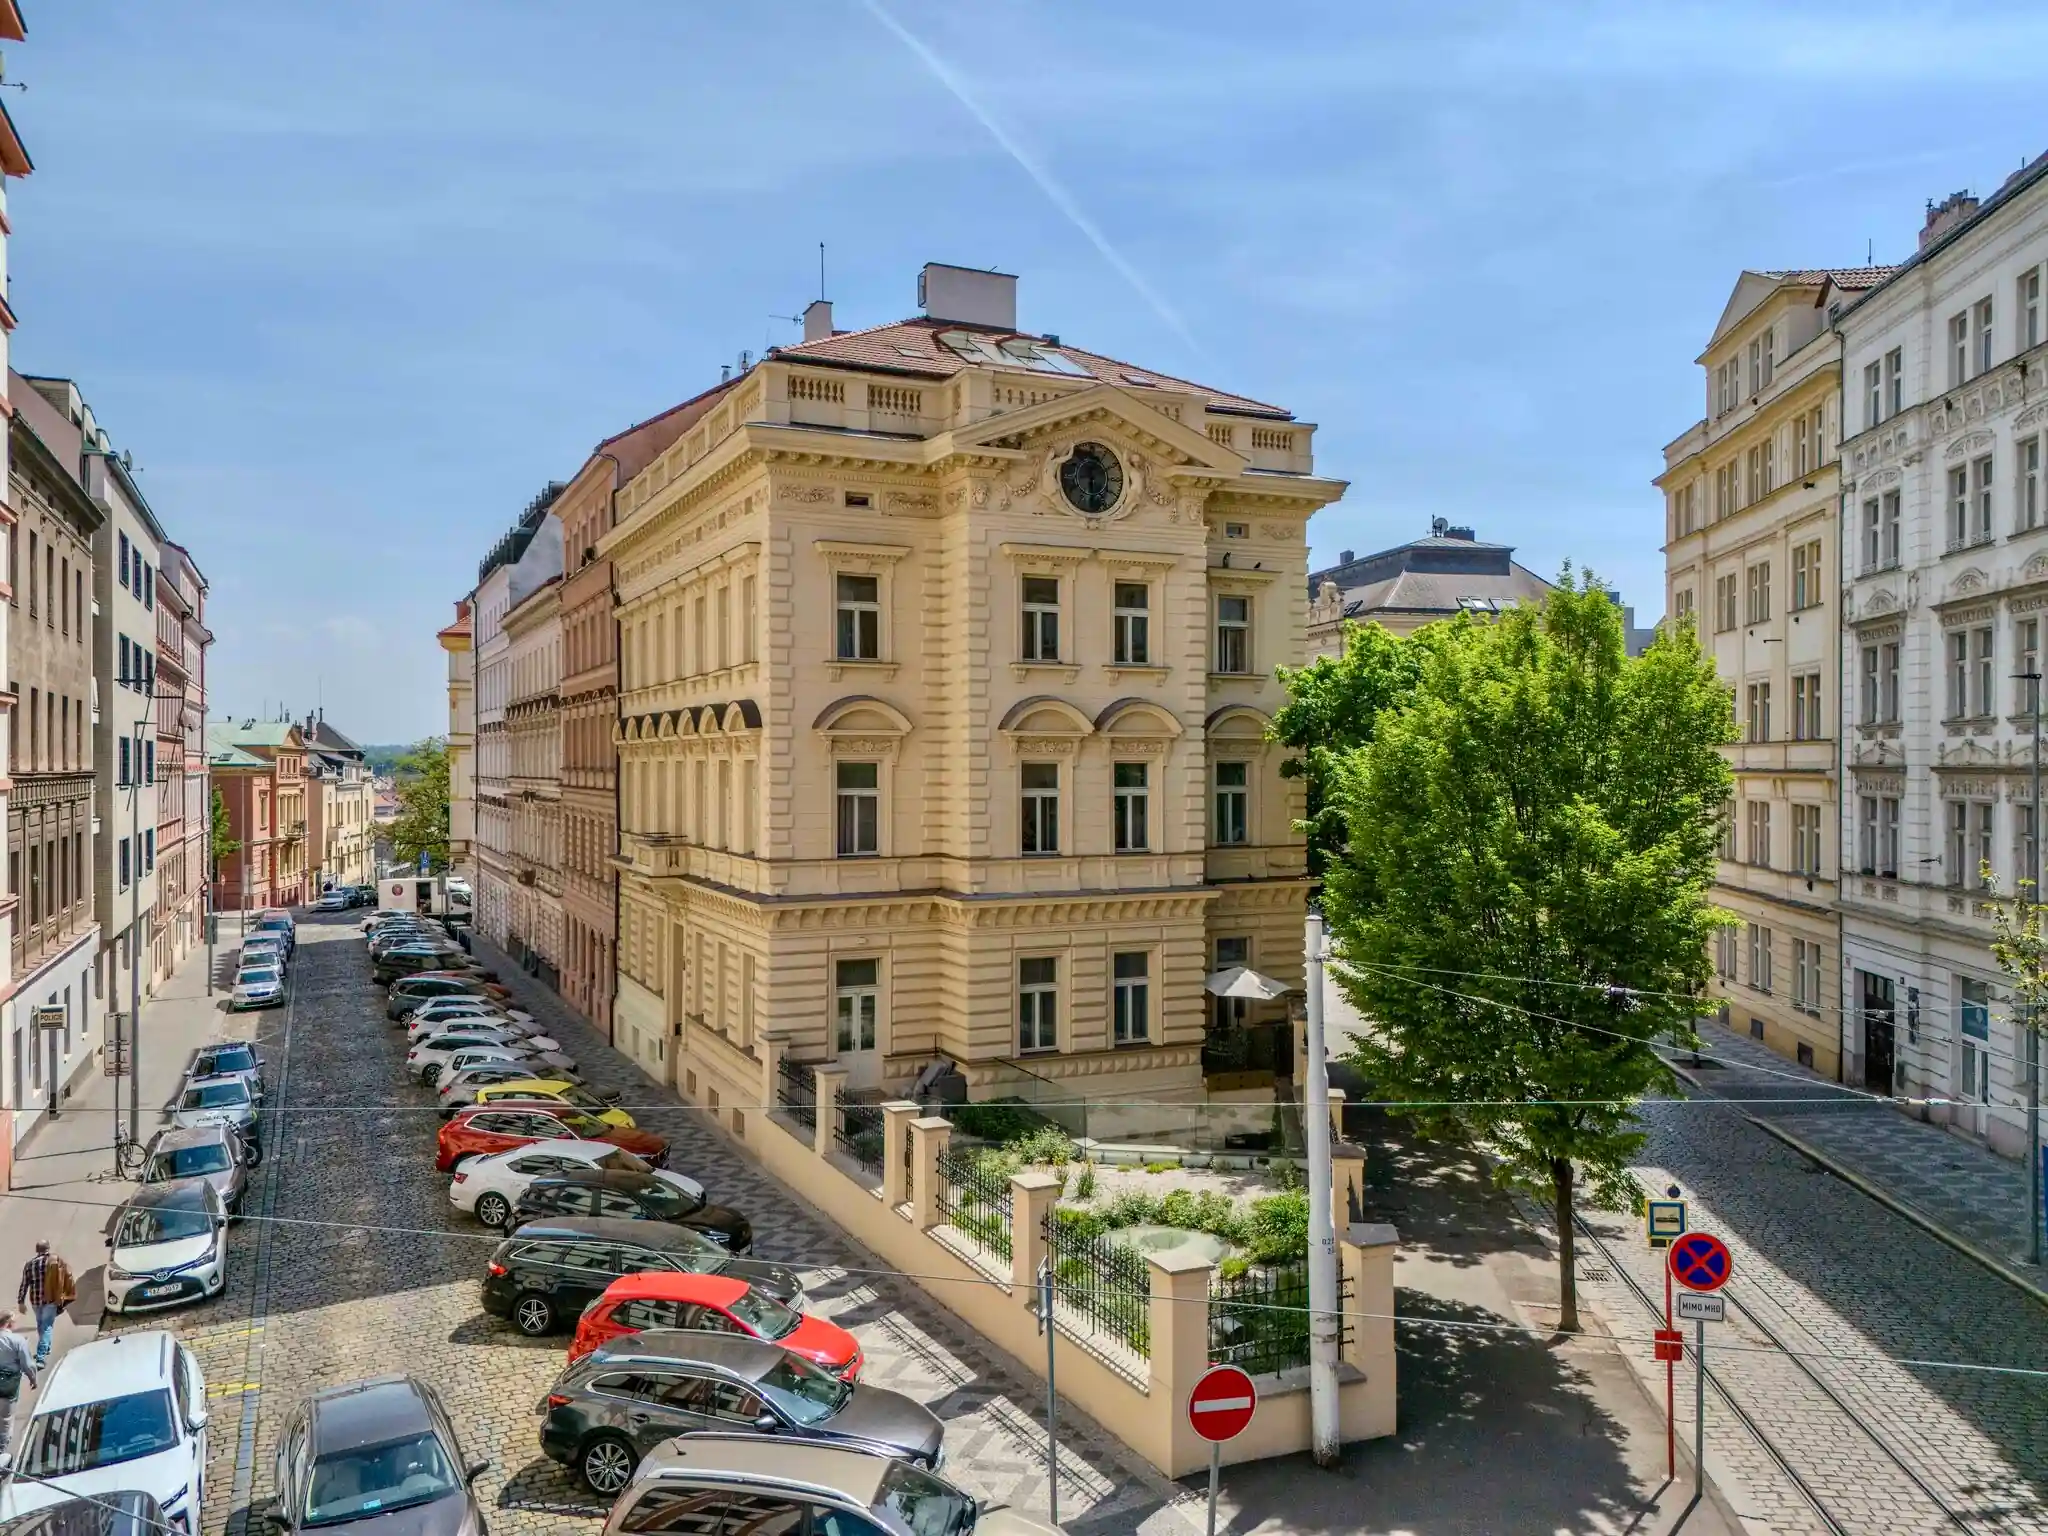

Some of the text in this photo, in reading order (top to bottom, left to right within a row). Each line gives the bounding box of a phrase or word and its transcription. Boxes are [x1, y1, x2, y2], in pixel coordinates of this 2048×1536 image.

[41, 1013, 63, 1021] POLICIE
[1682, 1301, 1721, 1313] MIMO MHD
